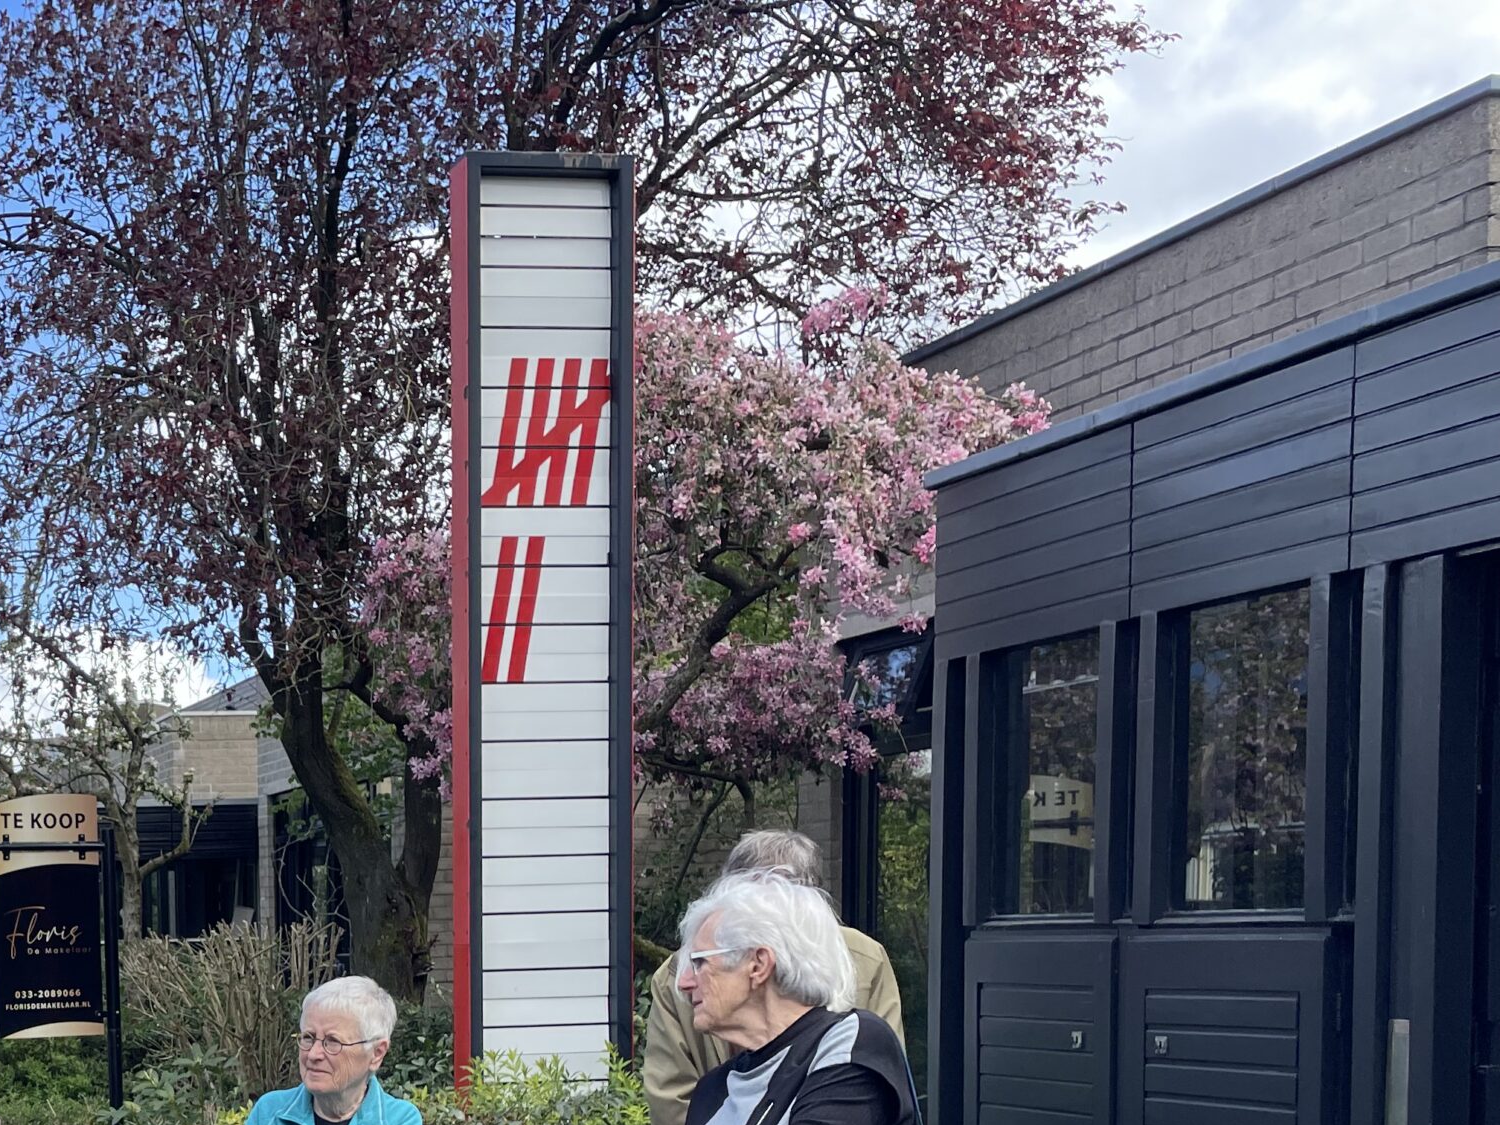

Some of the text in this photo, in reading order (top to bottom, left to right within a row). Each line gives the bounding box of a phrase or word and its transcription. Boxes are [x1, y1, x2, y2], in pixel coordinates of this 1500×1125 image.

[0, 812, 86, 829] TE KOOP
[4, 906, 83, 960] Floris
[27, 947, 40, 955] De
[14, 988, 81, 999] 033-2089066
[5, 1000, 92, 1011] FLORISDEMAKELAAR.NL
